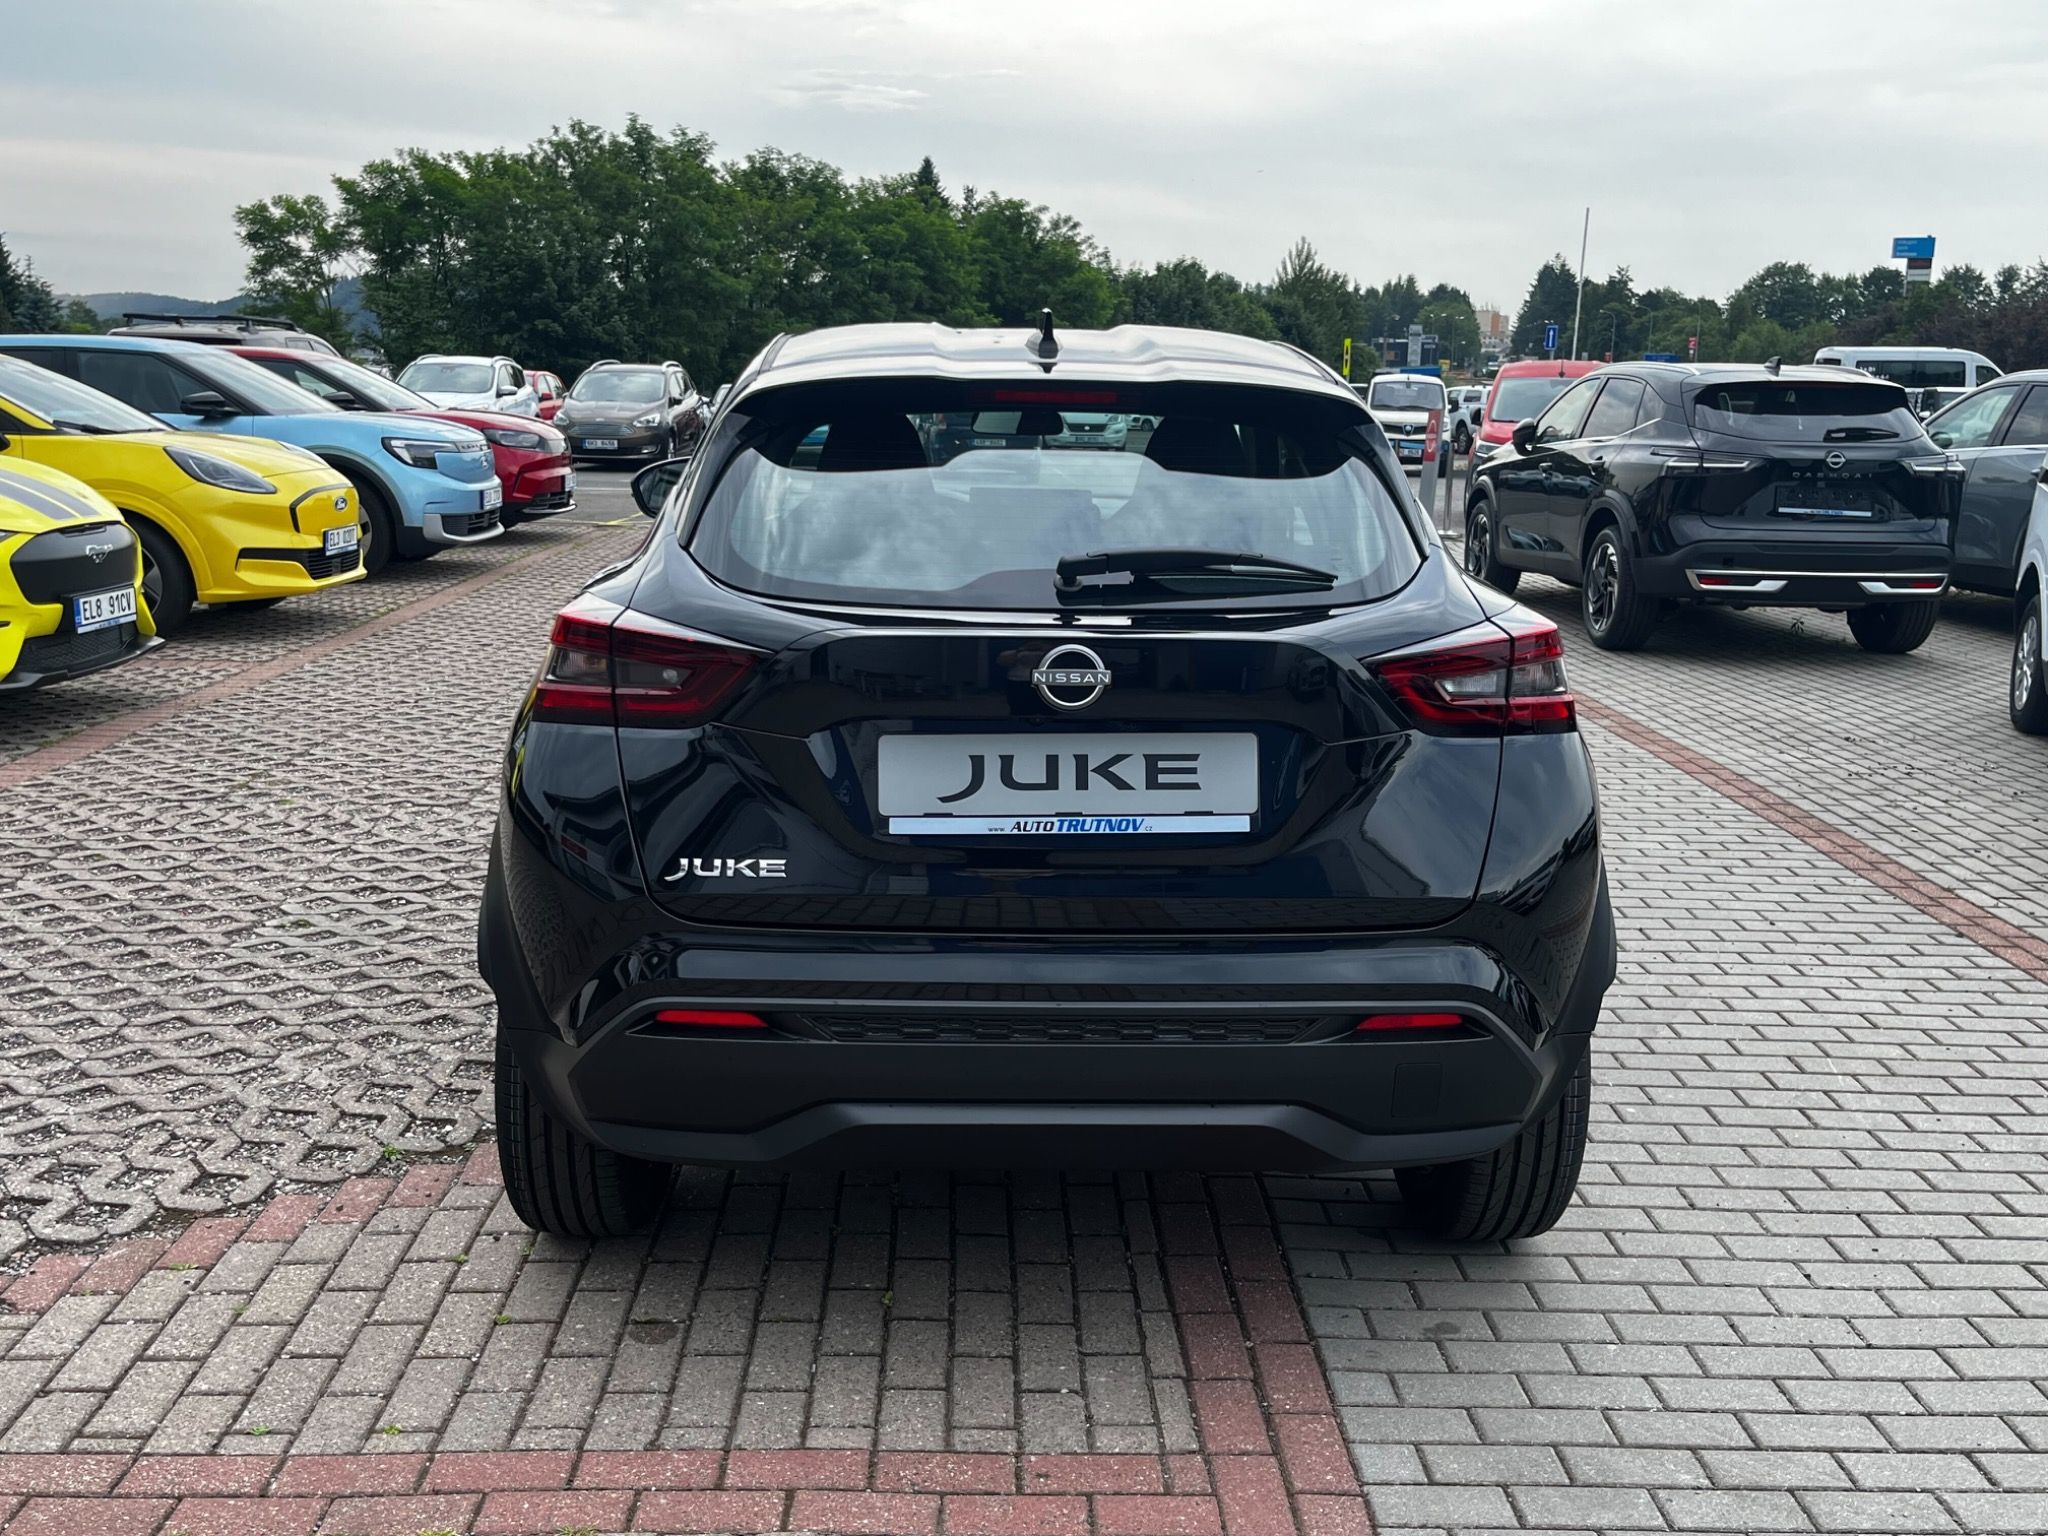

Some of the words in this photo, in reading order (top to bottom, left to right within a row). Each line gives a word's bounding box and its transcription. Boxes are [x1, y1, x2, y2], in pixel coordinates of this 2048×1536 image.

[82, 598, 103, 621] EL8
[109, 591, 132, 615] 91CV
[1034, 672, 1109, 683] NISSAN
[936, 754, 1202, 804] JUKE
[664, 857, 787, 882] JUKE
